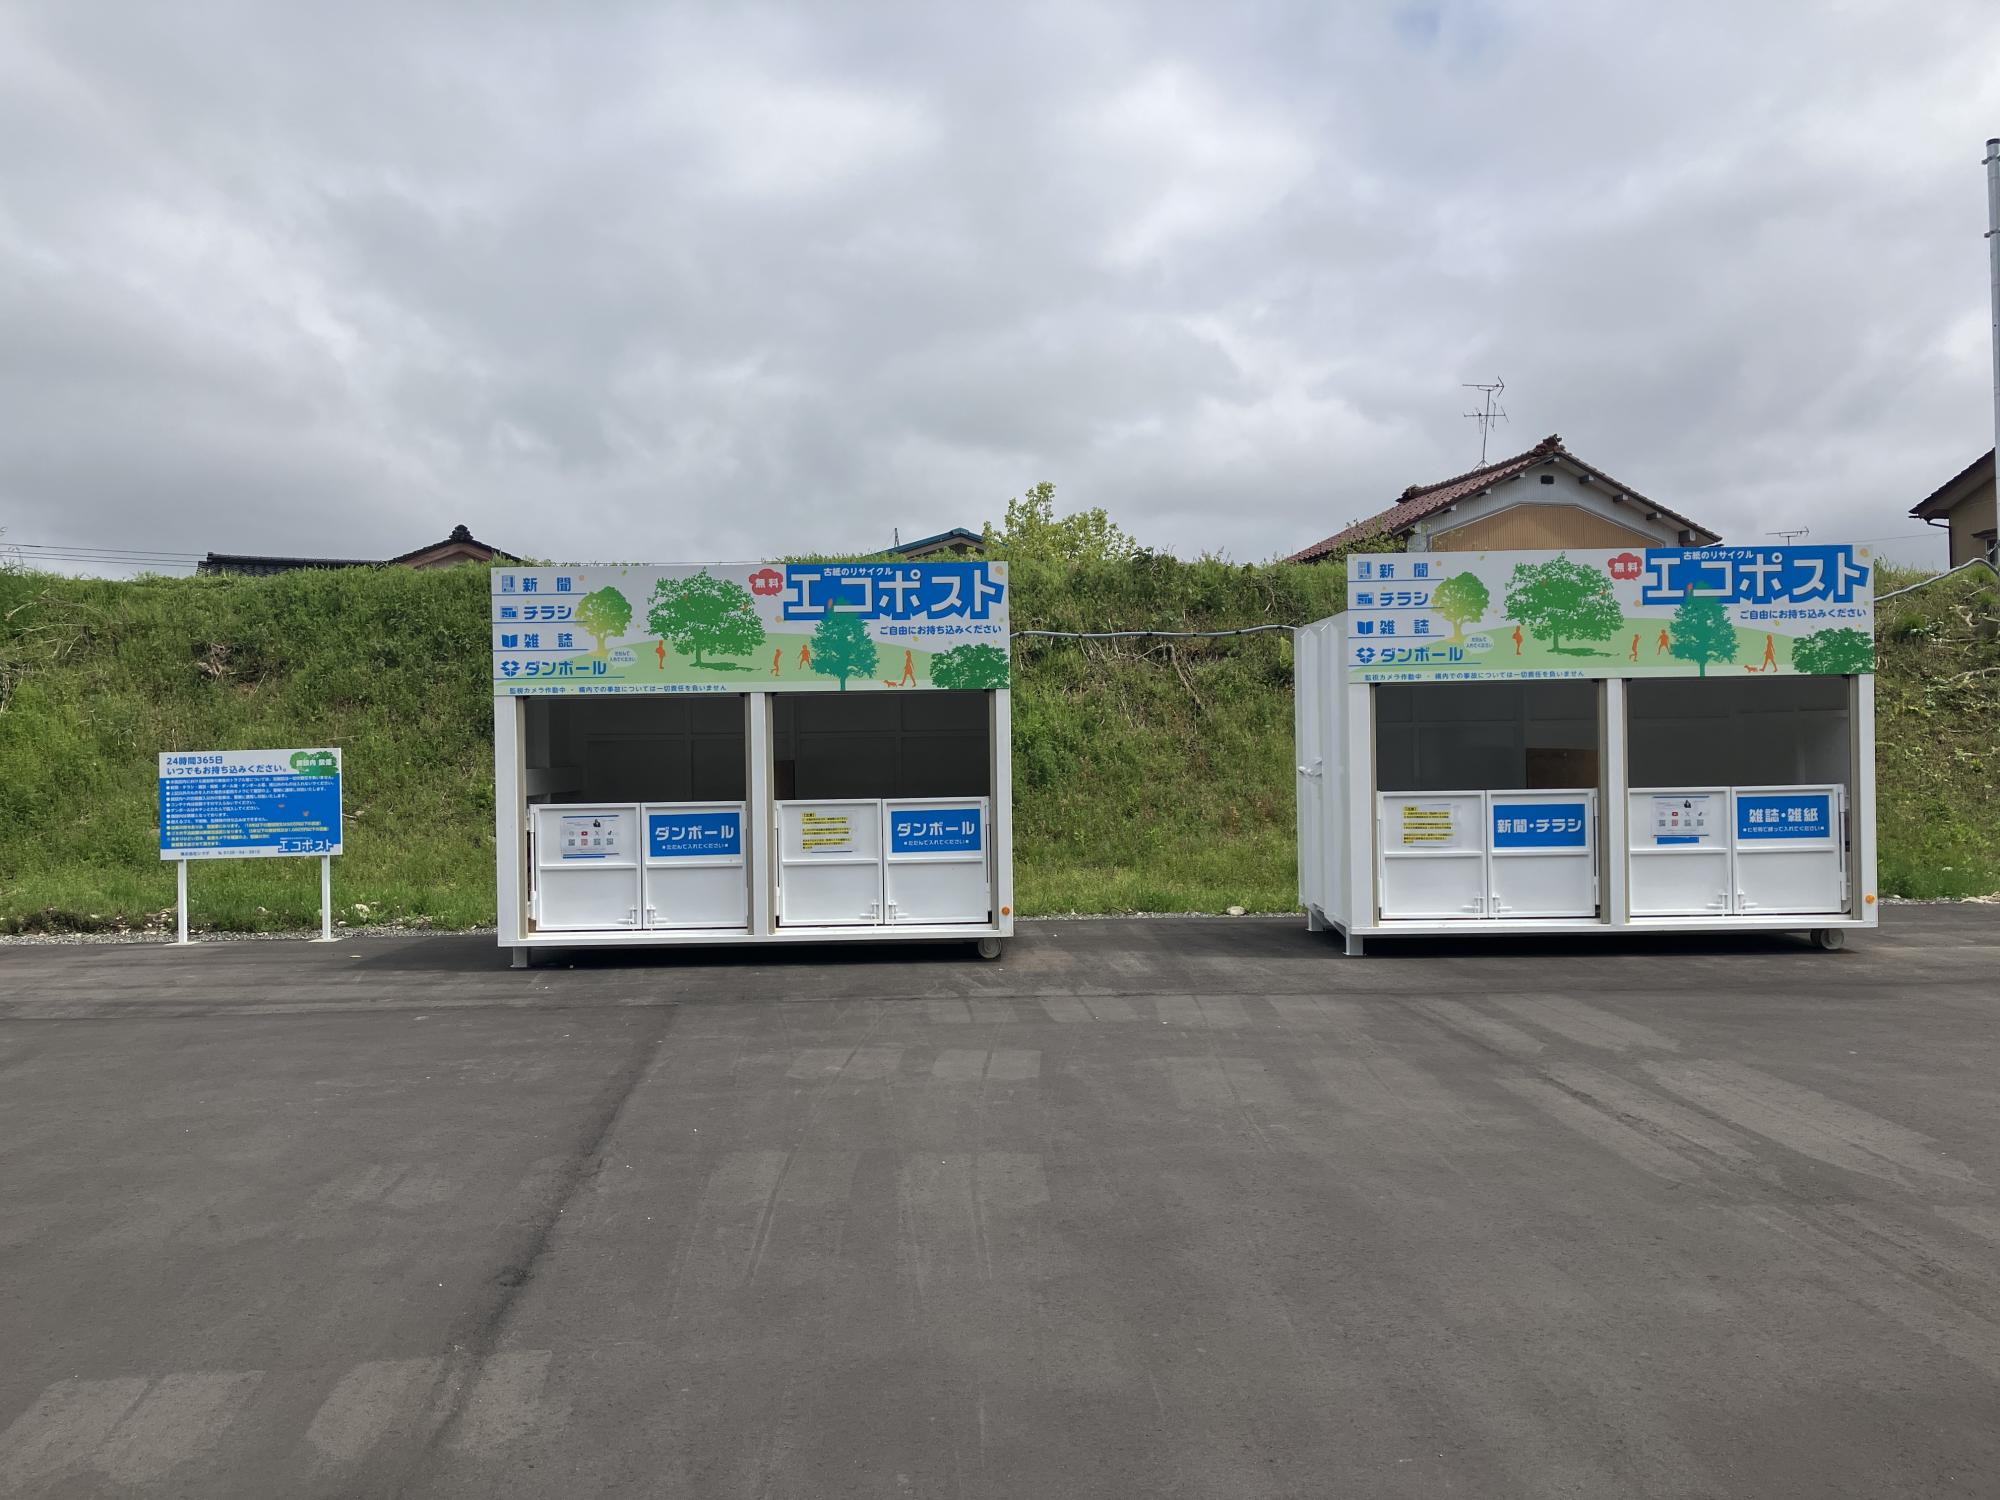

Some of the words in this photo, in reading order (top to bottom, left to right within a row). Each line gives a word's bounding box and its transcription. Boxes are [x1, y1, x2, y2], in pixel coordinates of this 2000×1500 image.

[1683, 551, 1754, 560] 古紙のリサイクル
[823, 567, 893, 577] 古紙のリサイクル
[1614, 562, 1639, 573] 無料
[1647, 552, 1861, 598] エコポスト
[755, 577, 779, 588] 無料
[788, 569, 996, 613] エコポスト
[1380, 591, 1429, 606] チラシ
[523, 605, 572, 620] チラシ
[1740, 608, 1867, 620] ご自由にお持ち込みください
[880, 625, 1002, 636] ご自由にお持ち込みください
[1380, 647, 1464, 663] ダンボール
[525, 661, 608, 676] ダンボール
[166, 756, 223, 766] 24時間365日
[166, 765, 288, 775] いつでもお持ち込みください。
[1749, 807, 1819, 823] 雑誌・雑紙
[897, 821, 975, 837] ダンボール
[1497, 817, 1582, 833] 新聞・チラシ
[655, 825, 735, 841] ダンボール
[279, 839, 333, 852] エコポスト
